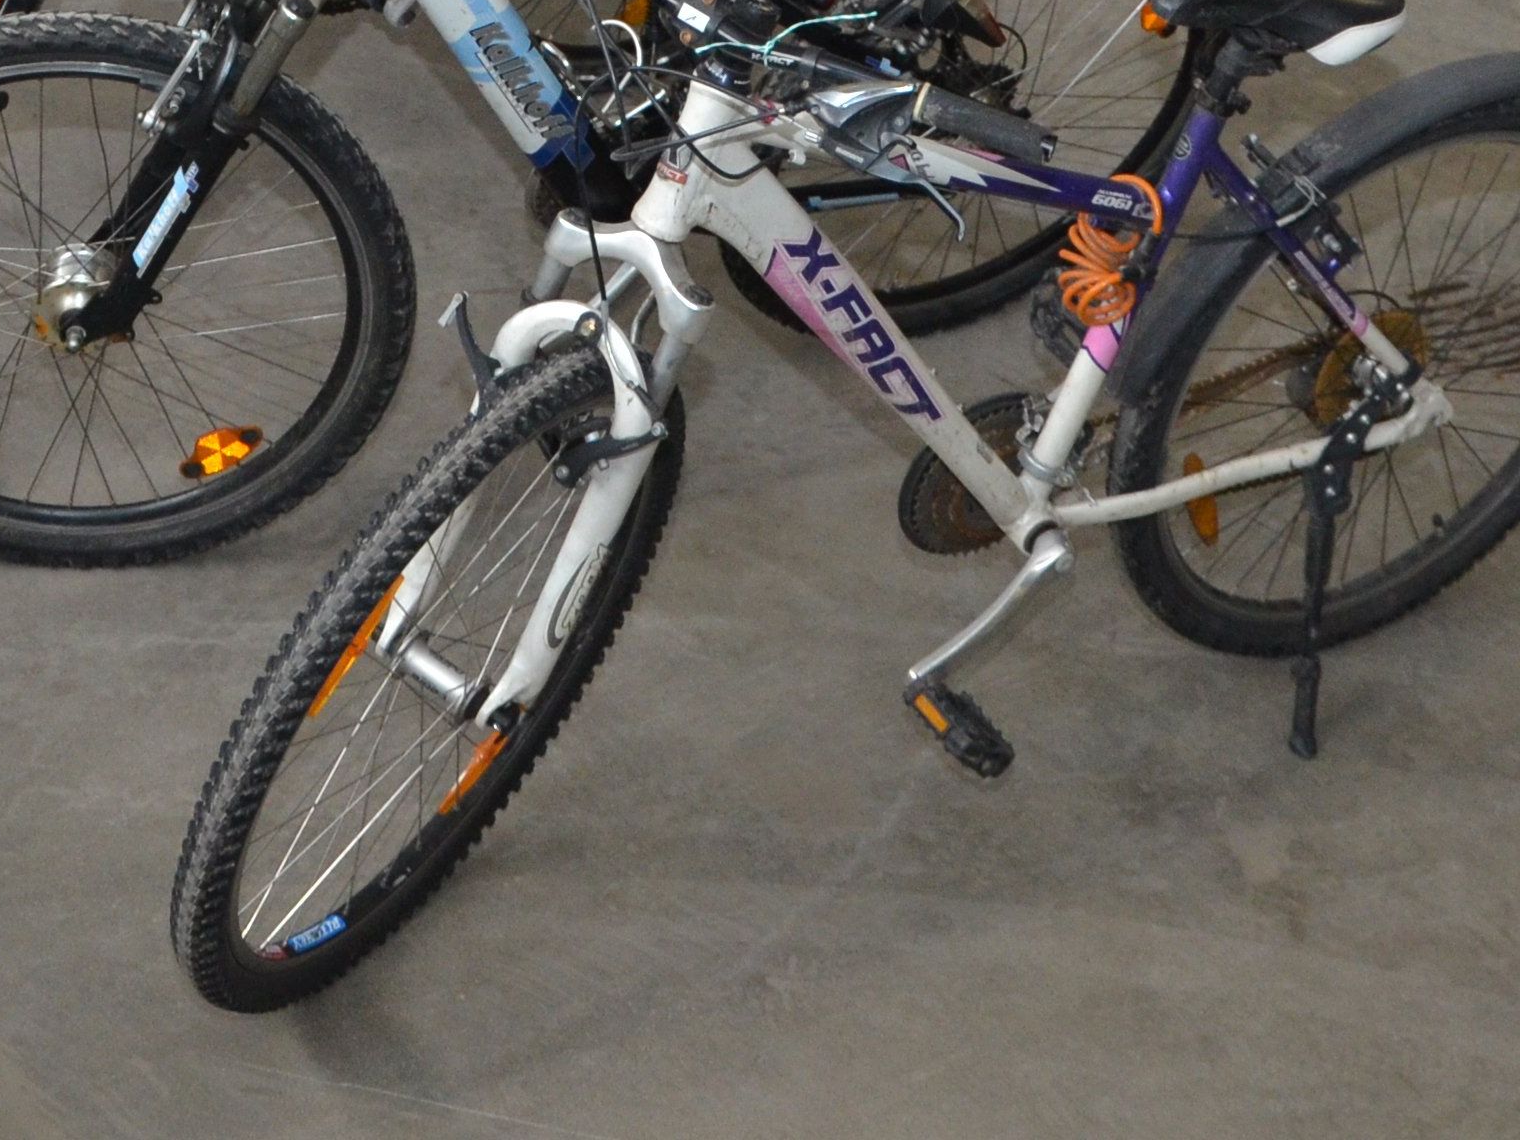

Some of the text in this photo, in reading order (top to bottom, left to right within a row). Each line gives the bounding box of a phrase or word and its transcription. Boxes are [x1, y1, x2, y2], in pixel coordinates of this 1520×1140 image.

[469, 22, 577, 139] Kalkhoff
[1091, 194, 1133, 211] 6061
[782, 226, 941, 421] X-FACT
